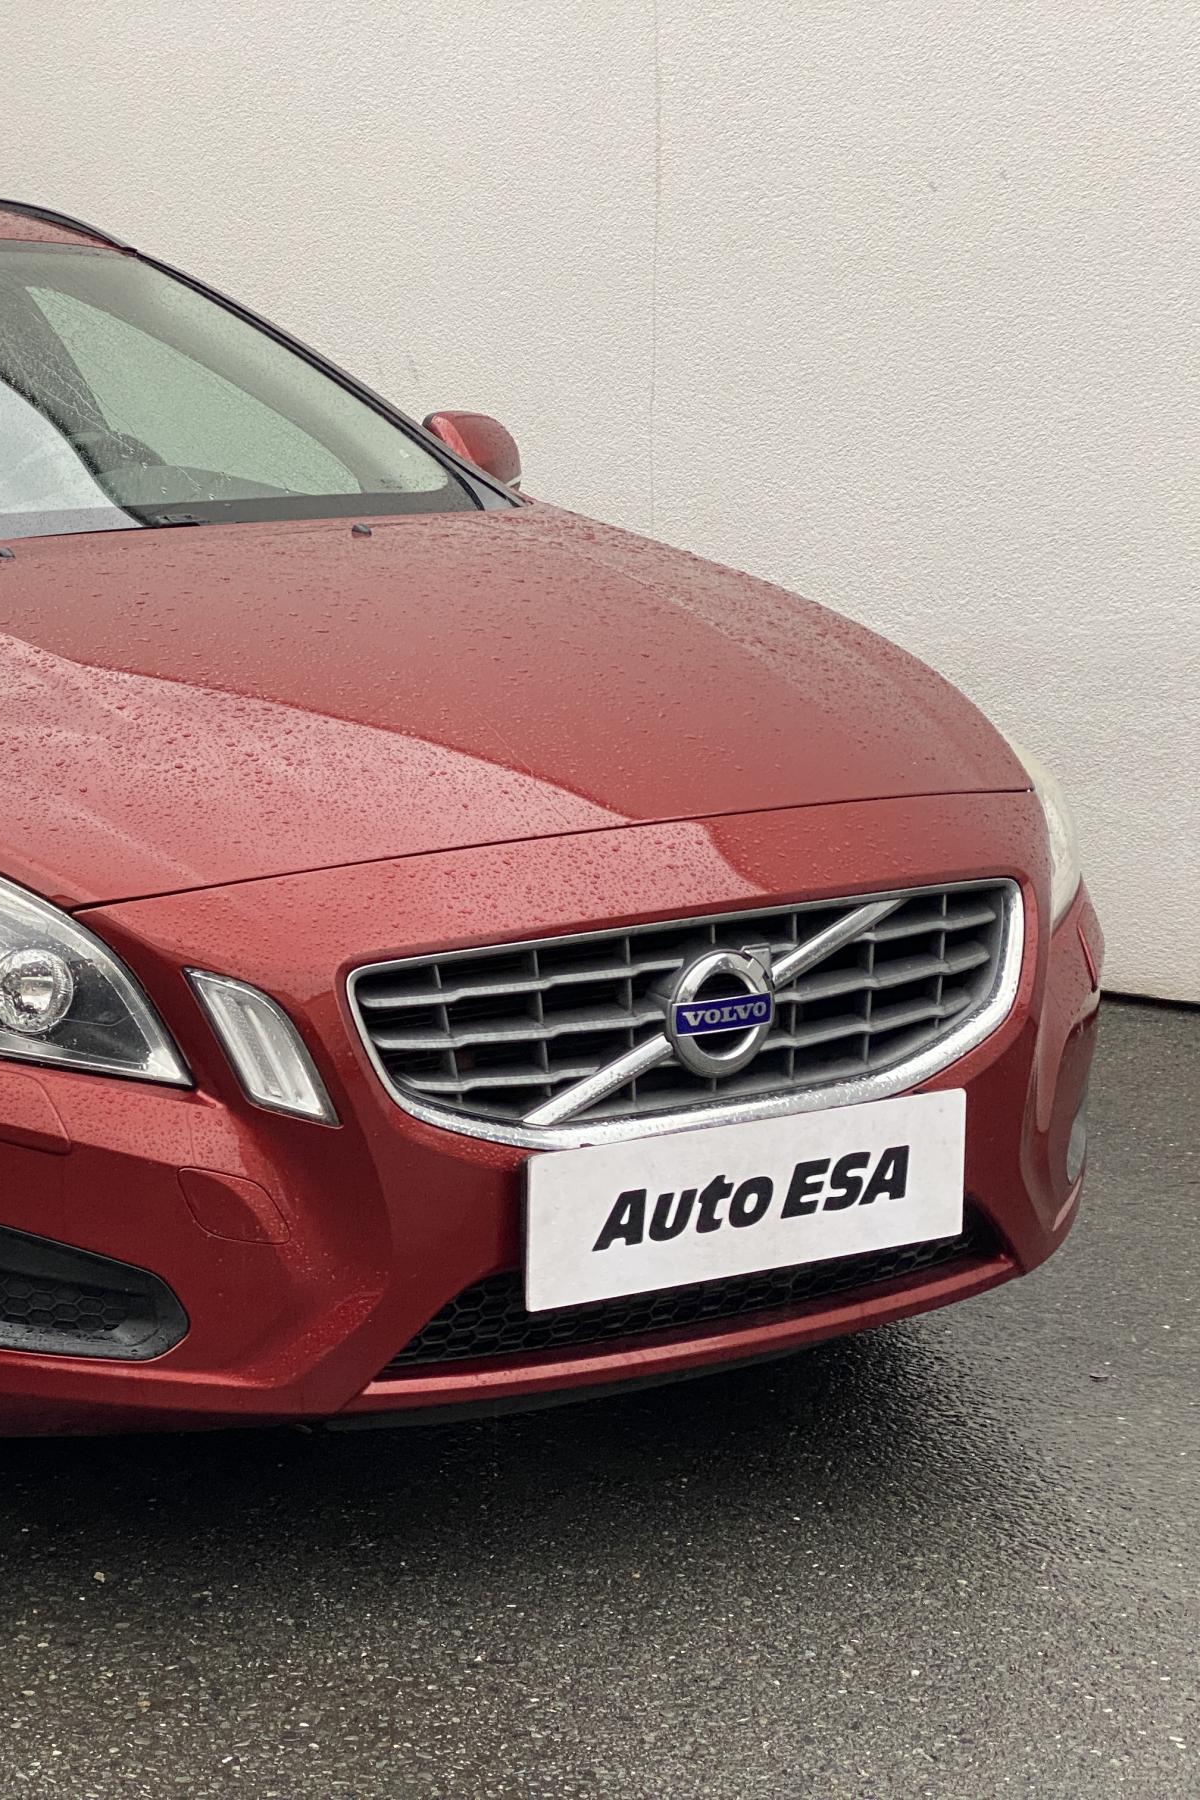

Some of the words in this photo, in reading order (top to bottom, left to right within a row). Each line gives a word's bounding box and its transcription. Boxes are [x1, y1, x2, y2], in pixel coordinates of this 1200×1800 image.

[681, 1001, 767, 1027] VOLVO
[592, 1174, 774, 1252] Auto
[780, 1144, 910, 1219] ESA
